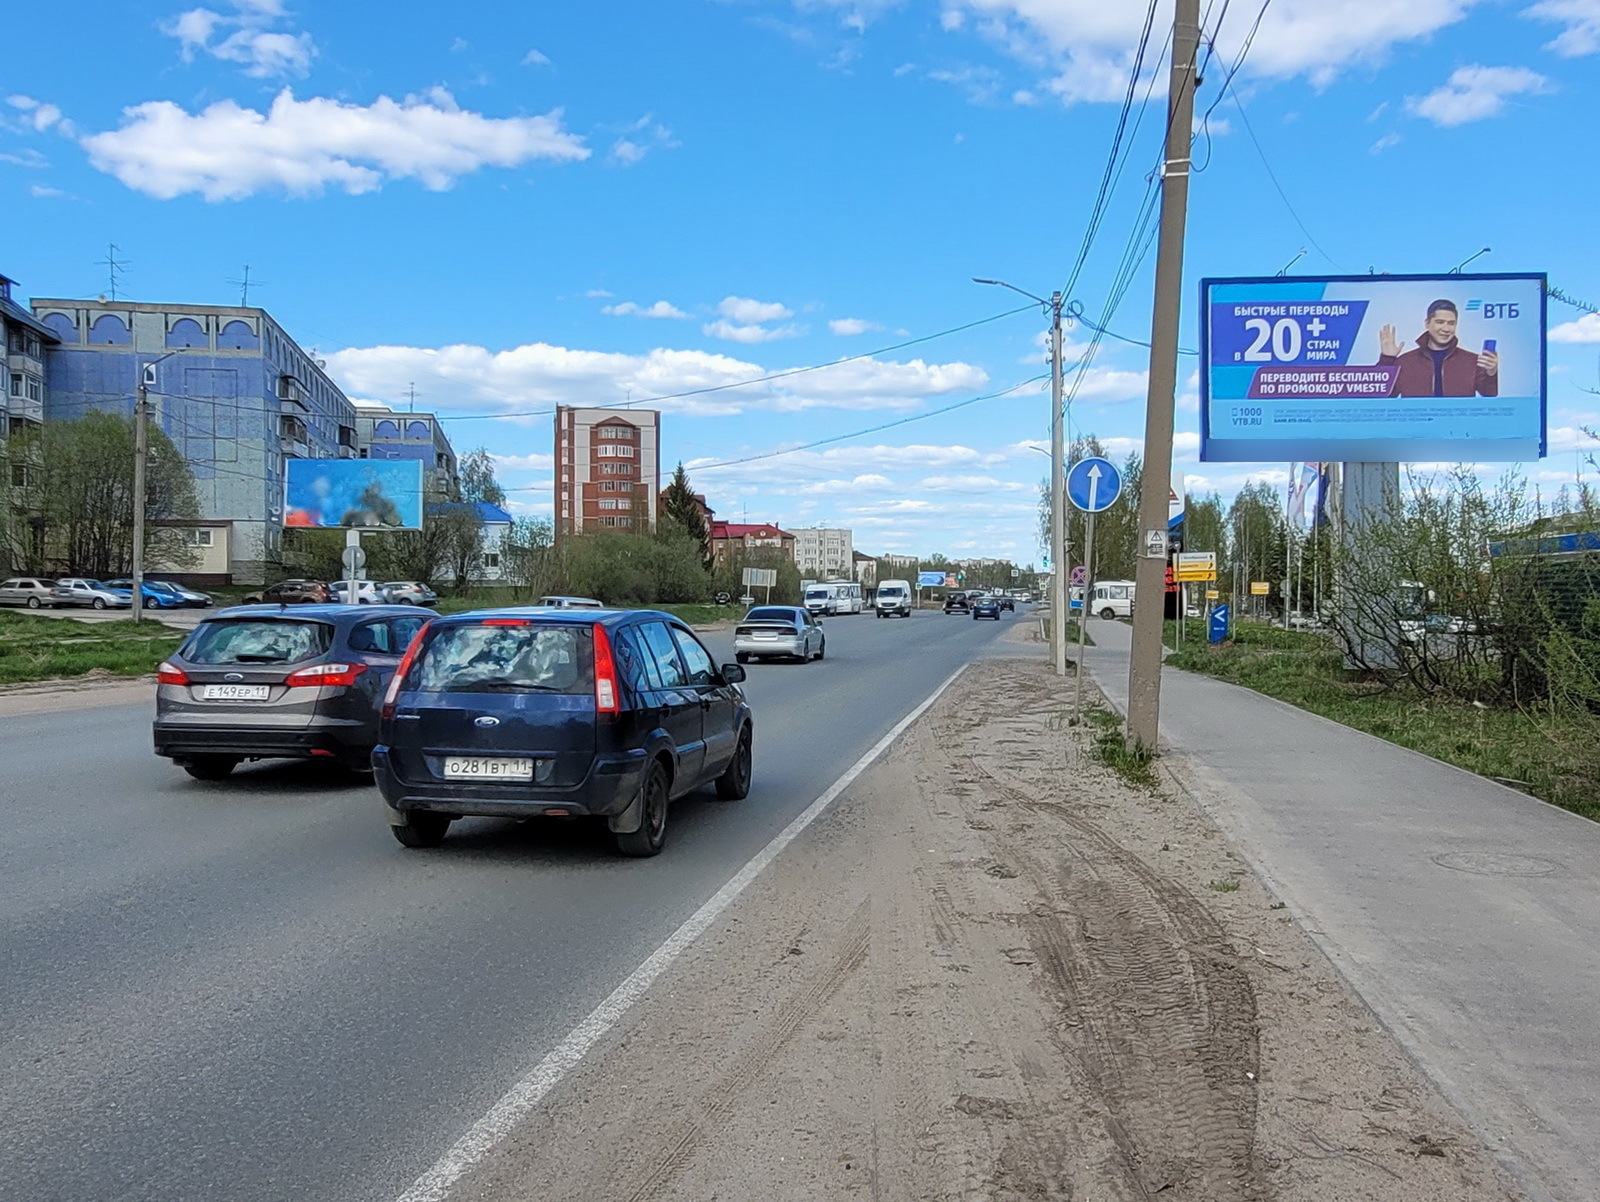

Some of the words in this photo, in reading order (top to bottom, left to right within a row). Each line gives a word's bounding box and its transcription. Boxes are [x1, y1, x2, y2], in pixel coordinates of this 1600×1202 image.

[1234, 306, 1286, 316] БЫСТРЫЕ
[1289, 305, 1349, 317] ПЕРЕВОДЫ
[1484, 303, 1520, 319] ВТБ
[1306, 340, 1340, 349] СТРАН
[1306, 351, 1337, 360] МИРА
[1260, 373, 1326, 383] ПЕРЕВОДИТЕ
[1328, 372, 1390, 382] БЕСПЛАТНО
[1260, 384, 1275, 394] ПО
[1277, 384, 1345, 395] ПРОМОКОДУ
[1346, 383, 1387, 393] VMESTE
[1239, 407, 1262, 417] 1000
[1232, 417, 1262, 426] VTB.RU
